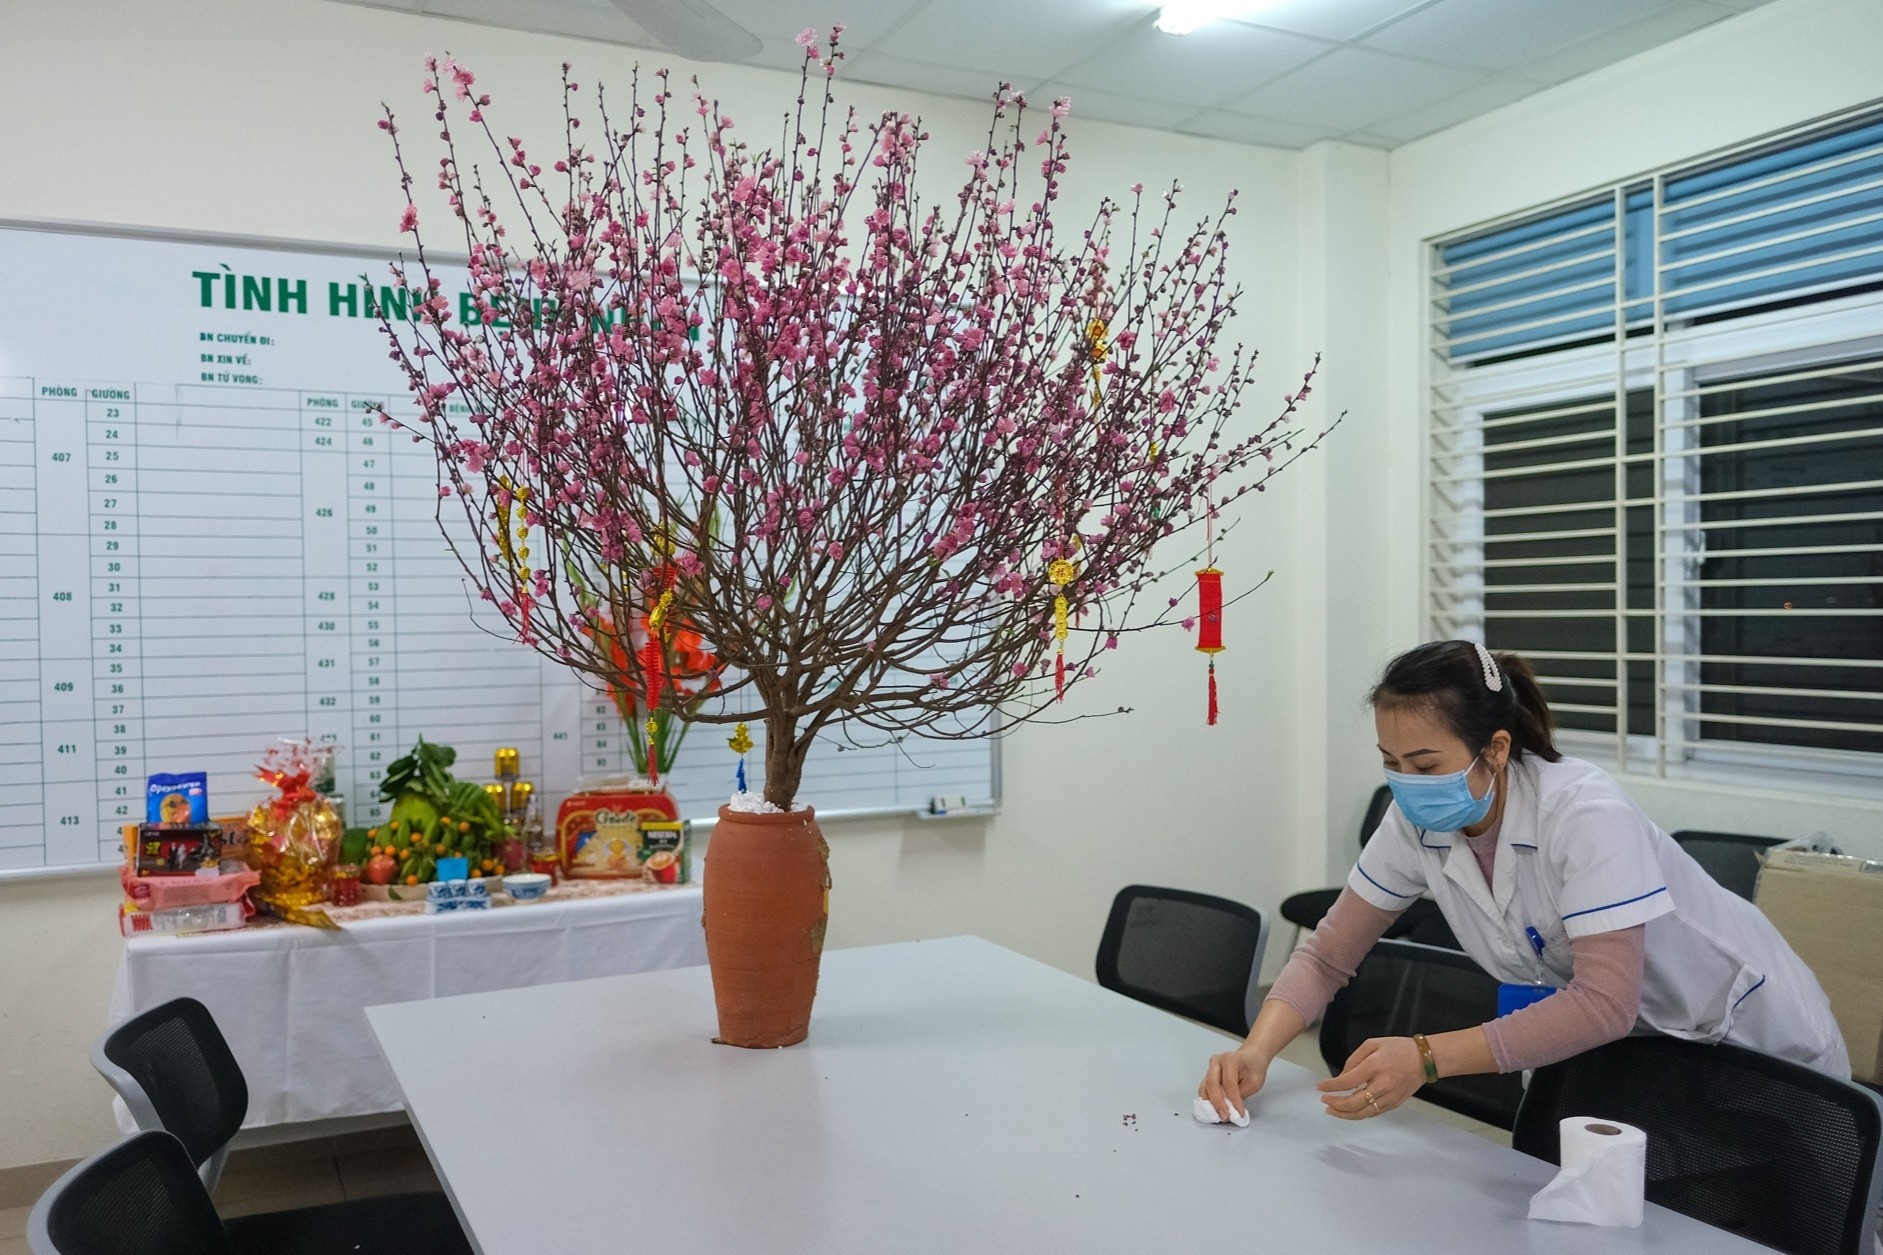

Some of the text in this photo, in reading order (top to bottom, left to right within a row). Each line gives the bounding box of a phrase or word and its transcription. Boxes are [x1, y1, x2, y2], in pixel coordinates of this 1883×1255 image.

[192, 263, 308, 315] TÌNH
[199, 332, 214, 342] BN
[200, 353, 214, 363] BN
[216, 355, 233, 364] XIN
[200, 372, 215, 382] BN
[106, 408, 120, 418] 23
[105, 429, 119, 439] 24
[51, 452, 72, 463] 407
[105, 451, 120, 461] 25
[104, 474, 118, 484] 26
[103, 498, 118, 509] 27
[104, 520, 117, 531] 28
[105, 540, 119, 551] 29
[107, 562, 121, 573] 30
[108, 582, 121, 593] 31
[52, 591, 73, 602] 408
[110, 602, 123, 613] 32
[109, 623, 123, 634] 33
[109, 643, 123, 654] 34
[110, 663, 123, 674] 35
[53, 681, 74, 692] 409
[111, 683, 124, 694] 36
[111, 704, 125, 715] 37
[113, 724, 127, 735] 38
[57, 744, 76, 754] 411
[114, 745, 127, 756] 39
[114, 765, 128, 775] 40
[114, 786, 127, 796] 41
[115, 805, 128, 815] 42
[59, 815, 80, 826] 413
